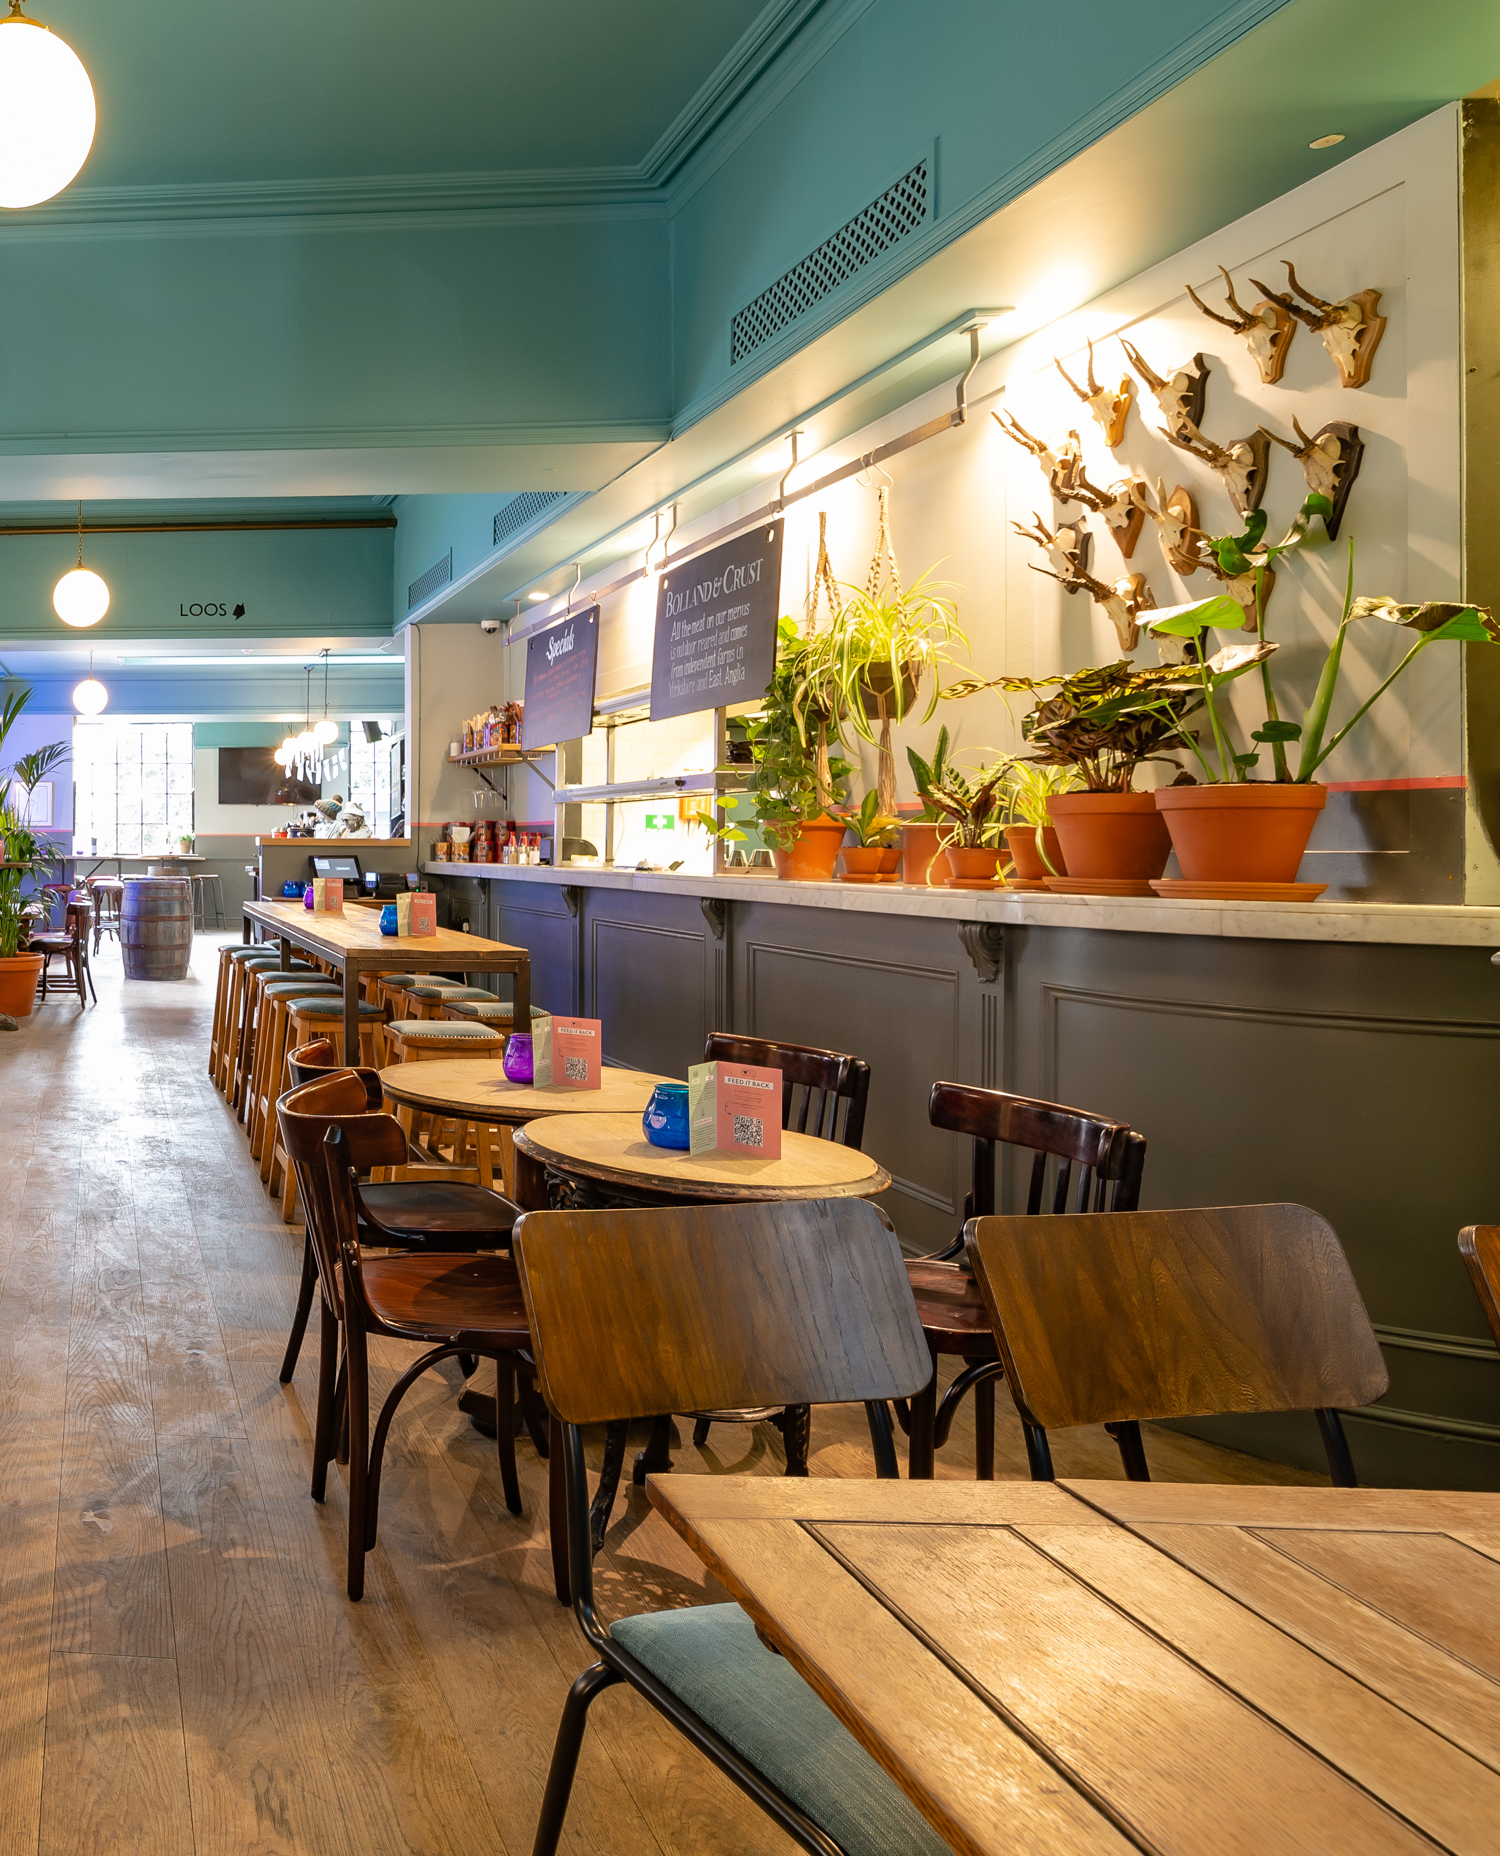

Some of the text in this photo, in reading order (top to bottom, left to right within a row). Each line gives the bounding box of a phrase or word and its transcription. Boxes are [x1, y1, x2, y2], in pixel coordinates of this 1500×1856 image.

[180, 603, 227, 617] LOOS
[670, 603, 751, 641] All the meat on our menus
[546, 623, 575, 666] Specials
[670, 645, 676, 660] is
[698, 629, 718, 652] reared
[718, 625, 730, 645] and
[730, 625, 748, 641] comes
[670, 645, 744, 679] from independent farms in
[668, 663, 745, 698] Yorkshire and East Anglia
[727, 1077, 745, 1085] FEED
[752, 1080, 770, 1089] BACK
